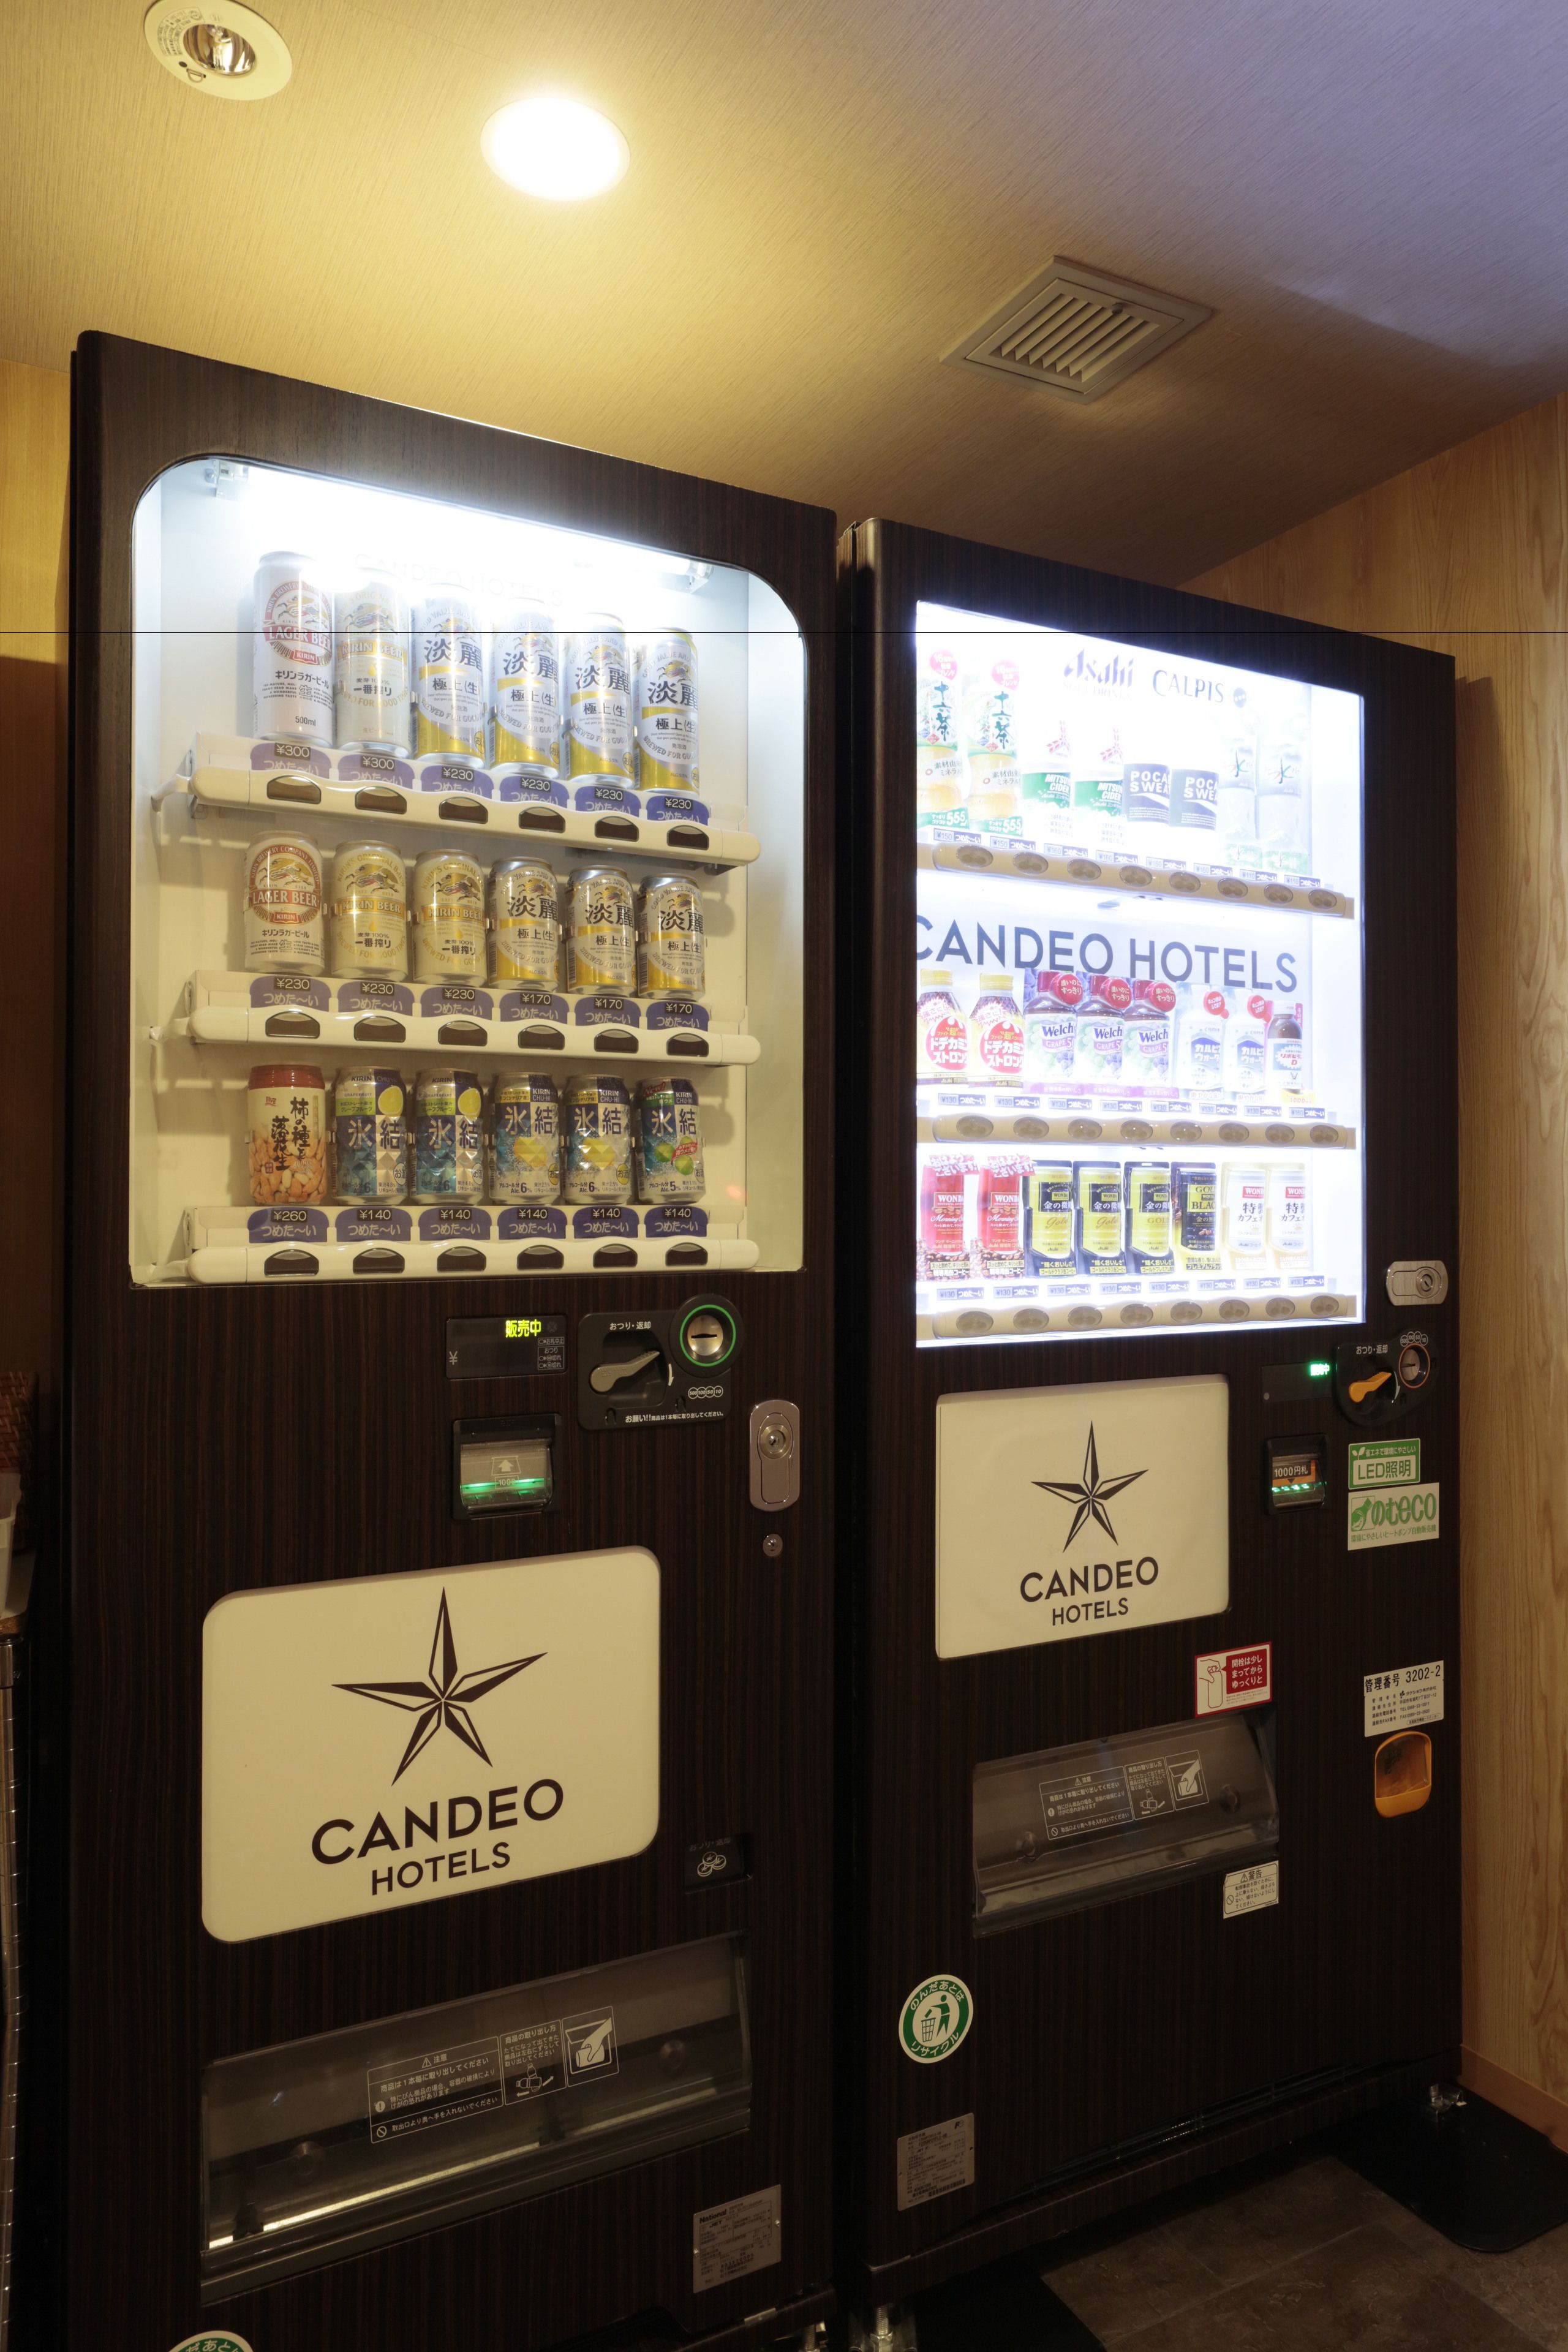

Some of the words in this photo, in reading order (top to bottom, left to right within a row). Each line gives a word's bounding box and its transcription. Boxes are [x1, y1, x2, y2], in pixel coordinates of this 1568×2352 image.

[270, 625, 309, 643] LAGER
[311, 631, 333, 653] BEER
[341, 643, 373, 655] KIRIN
[424, 638, 483, 673] 淡麗
[296, 652, 315, 661] KIRIN
[503, 651, 559, 684] 淡麗
[1063, 648, 1135, 688] Asahi
[275, 670, 330, 690] キリンラガービール
[575, 665, 630, 696] 淡麗
[1152, 669, 1224, 703] CALPIS
[353, 684, 391, 696] 一番搾り
[647, 682, 699, 712] 淡麗
[932, 680, 953, 742] 十六茶
[295, 716, 316, 726] 500ml
[992, 690, 1015, 750] 十六茶
[276, 744, 310, 758] ¥300
[363, 757, 395, 770] ¥300
[443, 767, 473, 781] ¥230
[521, 778, 550, 791] ¥230
[595, 788, 623, 801] ¥230
[665, 798, 692, 810] ¥230
[936, 831, 953, 840] ¥150
[992, 839, 1009, 848] ¥150
[252, 890, 289, 905] LAGER
[292, 892, 318, 908] BEER
[342, 900, 374, 911] KIRIN
[377, 901, 402, 914] BEER
[507, 896, 559, 921] 淡麗
[428, 908, 460, 918] KIRIN
[462, 908, 483, 921] BEER
[584, 904, 634, 929] 淡麗
[657, 910, 704, 935] 淡麗
[262, 929, 310, 939] キリンラガービール
[354, 938, 392, 949] 一番搾り
[442, 945, 476, 955] 一番搾り
[916, 913, 1114, 975] CANDEO
[1129, 938, 1297, 993] HOTELS
[276, 979, 309, 990] ¥230
[362, 983, 393, 995] ¥230
[1060, 986, 1083, 995] すっきり
[444, 989, 475, 1000] ¥230
[522, 993, 551, 1005] ¥170
[595, 998, 622, 1009] ¥170
[666, 1003, 692, 1014] ¥170
[1045, 1039, 1066, 1048] GRAPE
[290, 1096, 311, 1159] 柿の種と
[505, 1106, 553, 1135] 氷結
[574, 1107, 622, 1137] 氷結
[652, 1107, 697, 1137] 氷結
[348, 1119, 402, 1150] 氷結
[429, 1119, 478, 1150] 氷結
[270, 1115, 292, 1171] 落花生
[274, 1211, 306, 1221] ¥260
[360, 1210, 391, 1220] ¥140
[440, 1209, 470, 1219] ¥140
[519, 1209, 548, 1218] ¥140
[593, 1208, 620, 1218] ¥140
[665, 1208, 691, 1218] ¥140
[940, 1290, 956, 1298] ¥130
[505, 1319, 541, 1338] 販売中
[609, 1321, 651, 1330] おつり・返却
[1356, 1344, 1388, 1355] おつり・返却
[449, 1351, 458, 1365] ¥
[1365, 1446, 1416, 1457] 省エネで環境にやさしい
[1275, 1464, 1308, 1477] 1000円札
[1358, 1460, 1411, 1480] LED照明
[1371, 1493, 1437, 1526] のむeco
[1019, 1556, 1159, 1603] CANDEO
[1052, 1597, 1129, 1626] HOTELS
[1231, 1655, 1262, 1668] 開栓は少し
[1232, 1665, 1262, 1679] まってから
[1365, 1673, 1400, 1693] 管理番号
[1405, 1665, 1441, 1684] 3202-2
[1232, 1676, 1262, 1689] ゆっくりと
[311, 1778, 564, 1866] CANDEO
[371, 1842, 511, 1896] HOTELS
[1248, 1868, 1262, 1881] 警告
[910, 1980, 965, 2011] のんだあとは
[505, 2024, 556, 2045] 商品の取り出し方
[503, 2034, 559, 2054] たてになって出てきた
[911, 2030, 960, 2057] リサイクル
[433, 2053, 448, 2064] 注意
[505, 2049, 555, 2067] 取り出してください
[380, 2057, 489, 2094] 商品は1本毎に取り出してください
[699, 2209, 728, 2225] National
